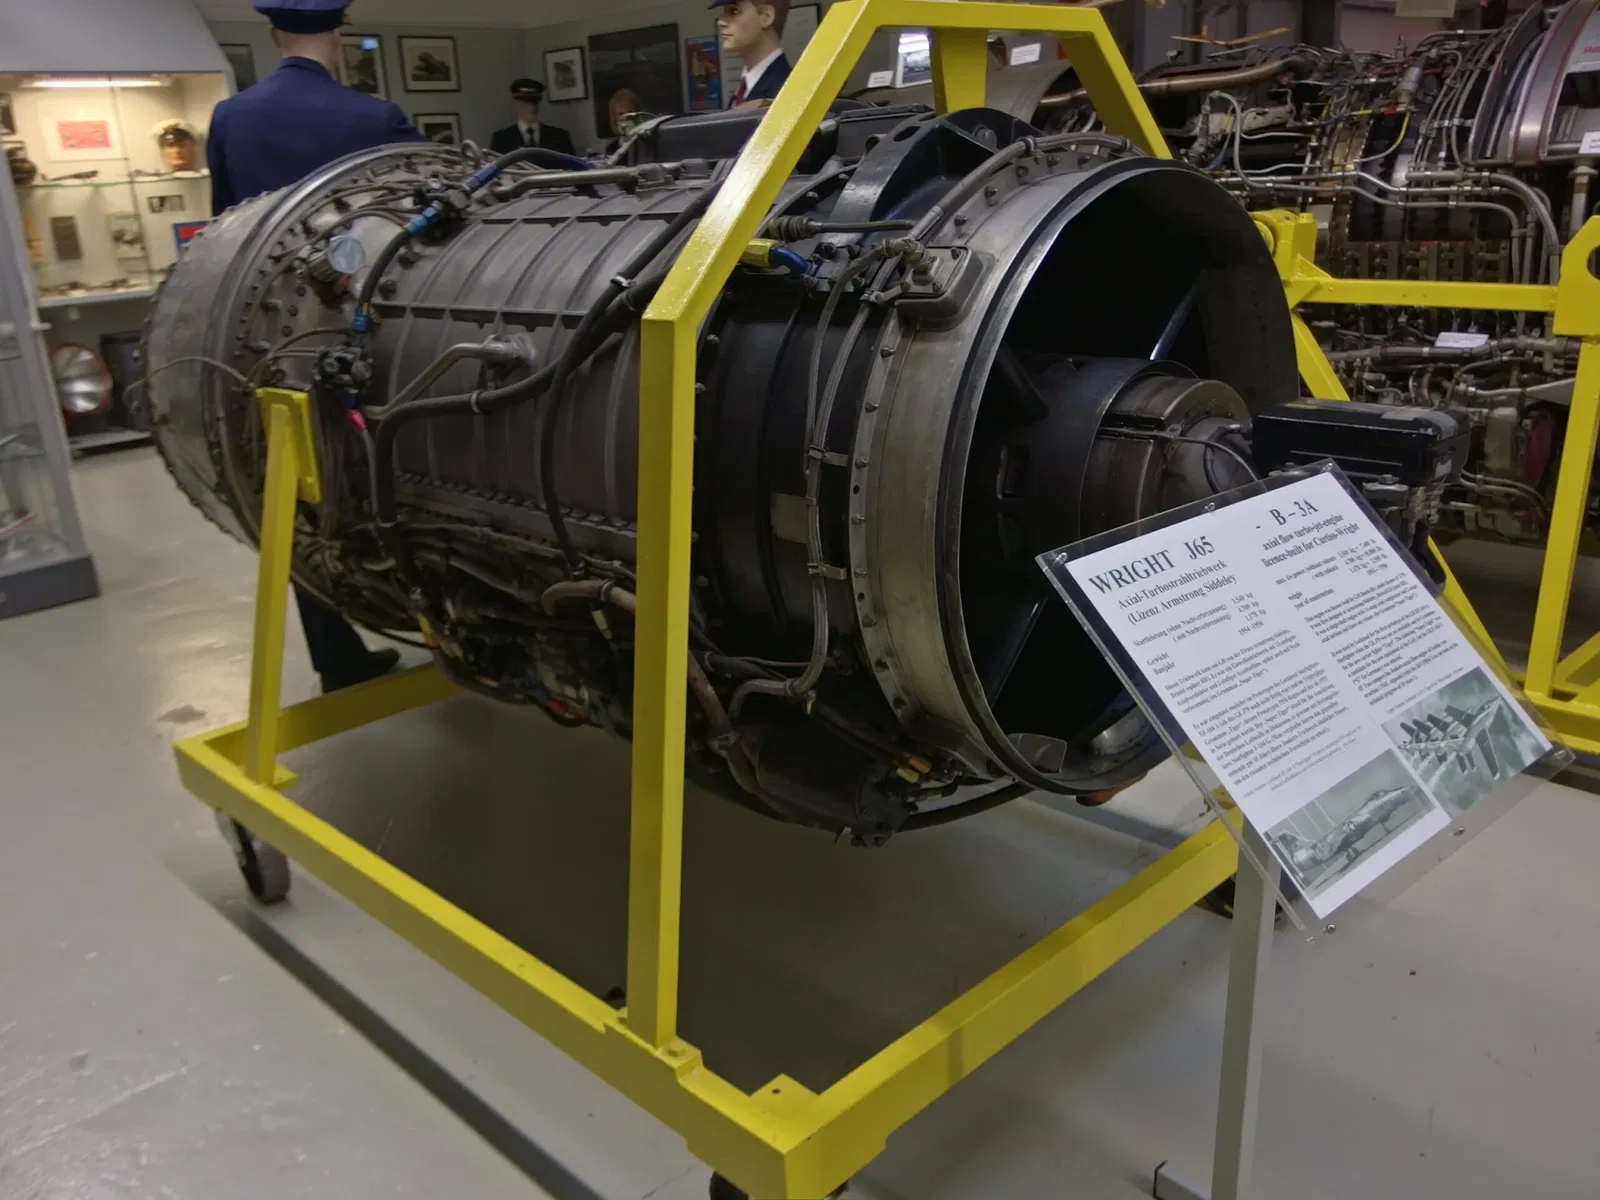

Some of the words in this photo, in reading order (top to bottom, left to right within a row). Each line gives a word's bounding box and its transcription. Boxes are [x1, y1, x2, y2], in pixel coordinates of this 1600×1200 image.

[1261, 545, 1304, 567] licence-built
[1301, 541, 1315, 551] for
[1313, 523, 1360, 546] Curtiss-Wright
[1262, 537, 1281, 551] axial
[1278, 533, 1295, 544] flow
[1089, 550, 1174, 593] WRIGHT
[1184, 536, 1214, 560] J65
[1119, 560, 1227, 608] Axial-Turbostrahltriebwerk
[1128, 606, 1161, 625] (Lizenz
[1161, 587, 1206, 610] Armstrong
[1203, 575, 1237, 592] Siddeley
[1146, 652, 1170, 666] Gewicht
[1153, 662, 1175, 675] Baujahr
